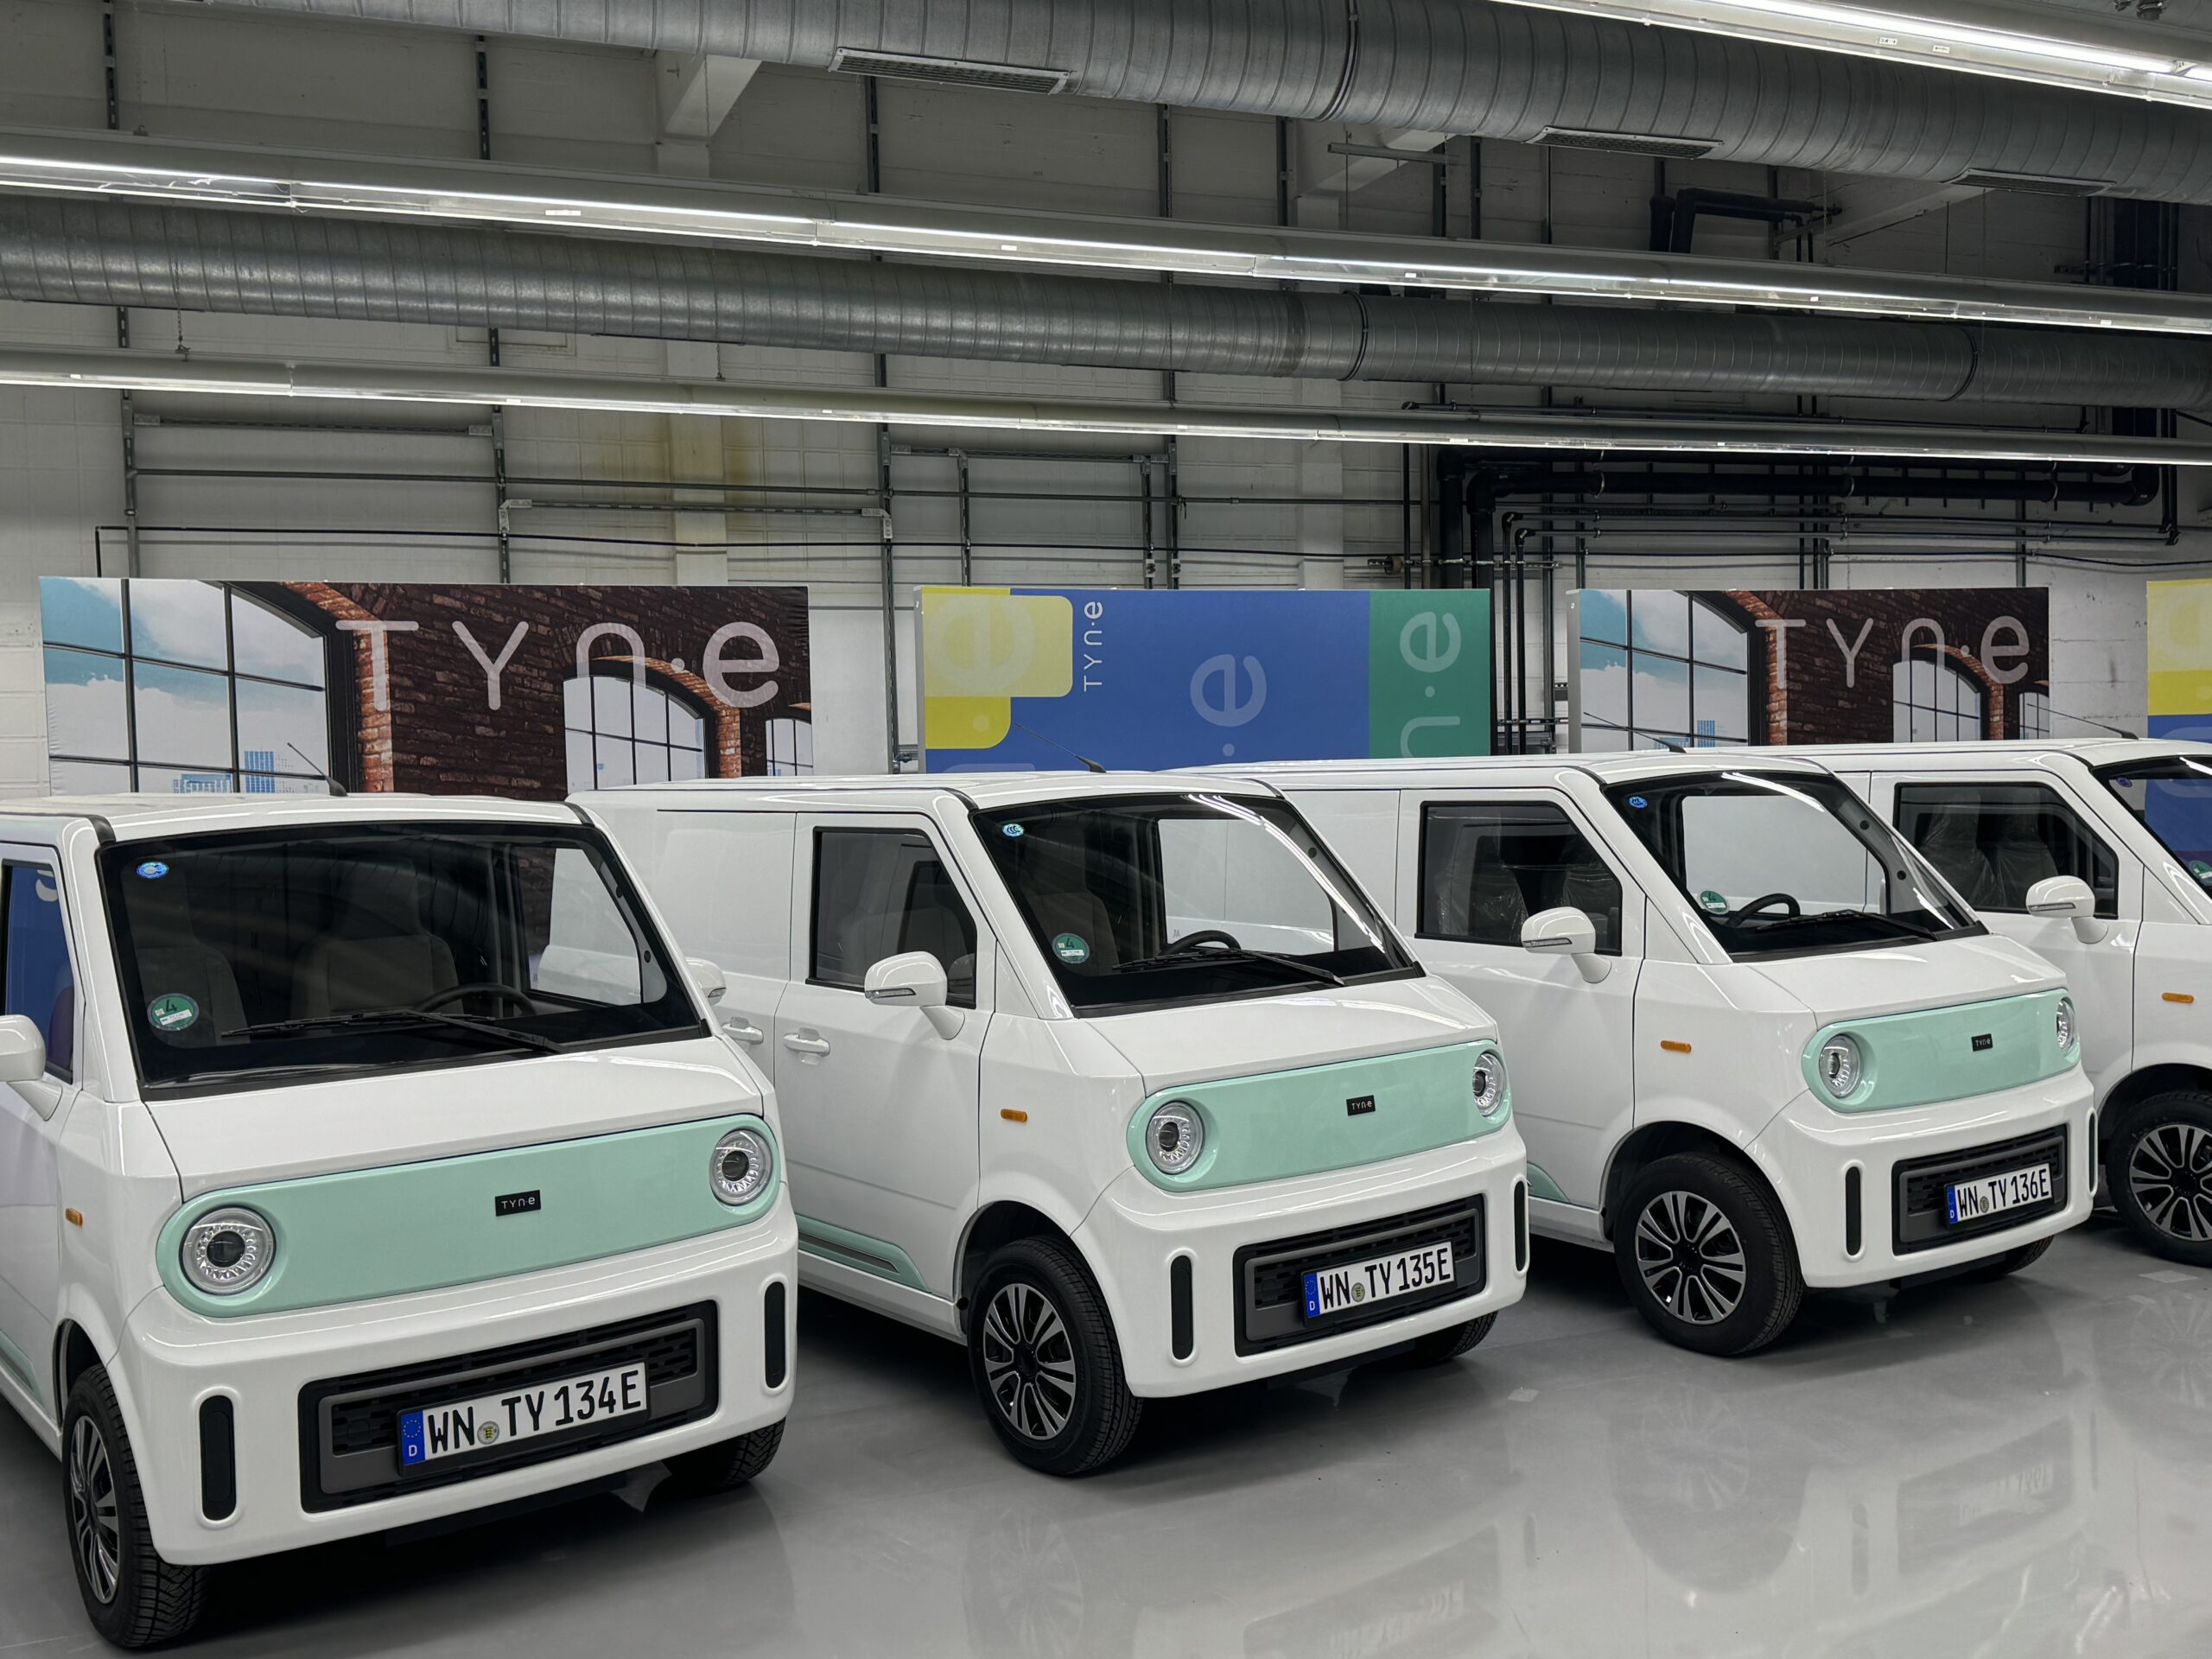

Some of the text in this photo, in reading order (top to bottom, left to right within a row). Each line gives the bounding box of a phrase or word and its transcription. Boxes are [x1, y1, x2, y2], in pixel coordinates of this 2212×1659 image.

[1065, 937, 1075, 949] 4
[165, 999, 177, 1012] 4
[1957, 1185, 1979, 1218] WN
[1949, 1210, 1955, 1218] D
[1319, 1271, 1351, 1310] WN
[1309, 1300, 1315, 1311] D
[428, 1406, 475, 1453] WN
[408, 1444, 418, 1458] D
